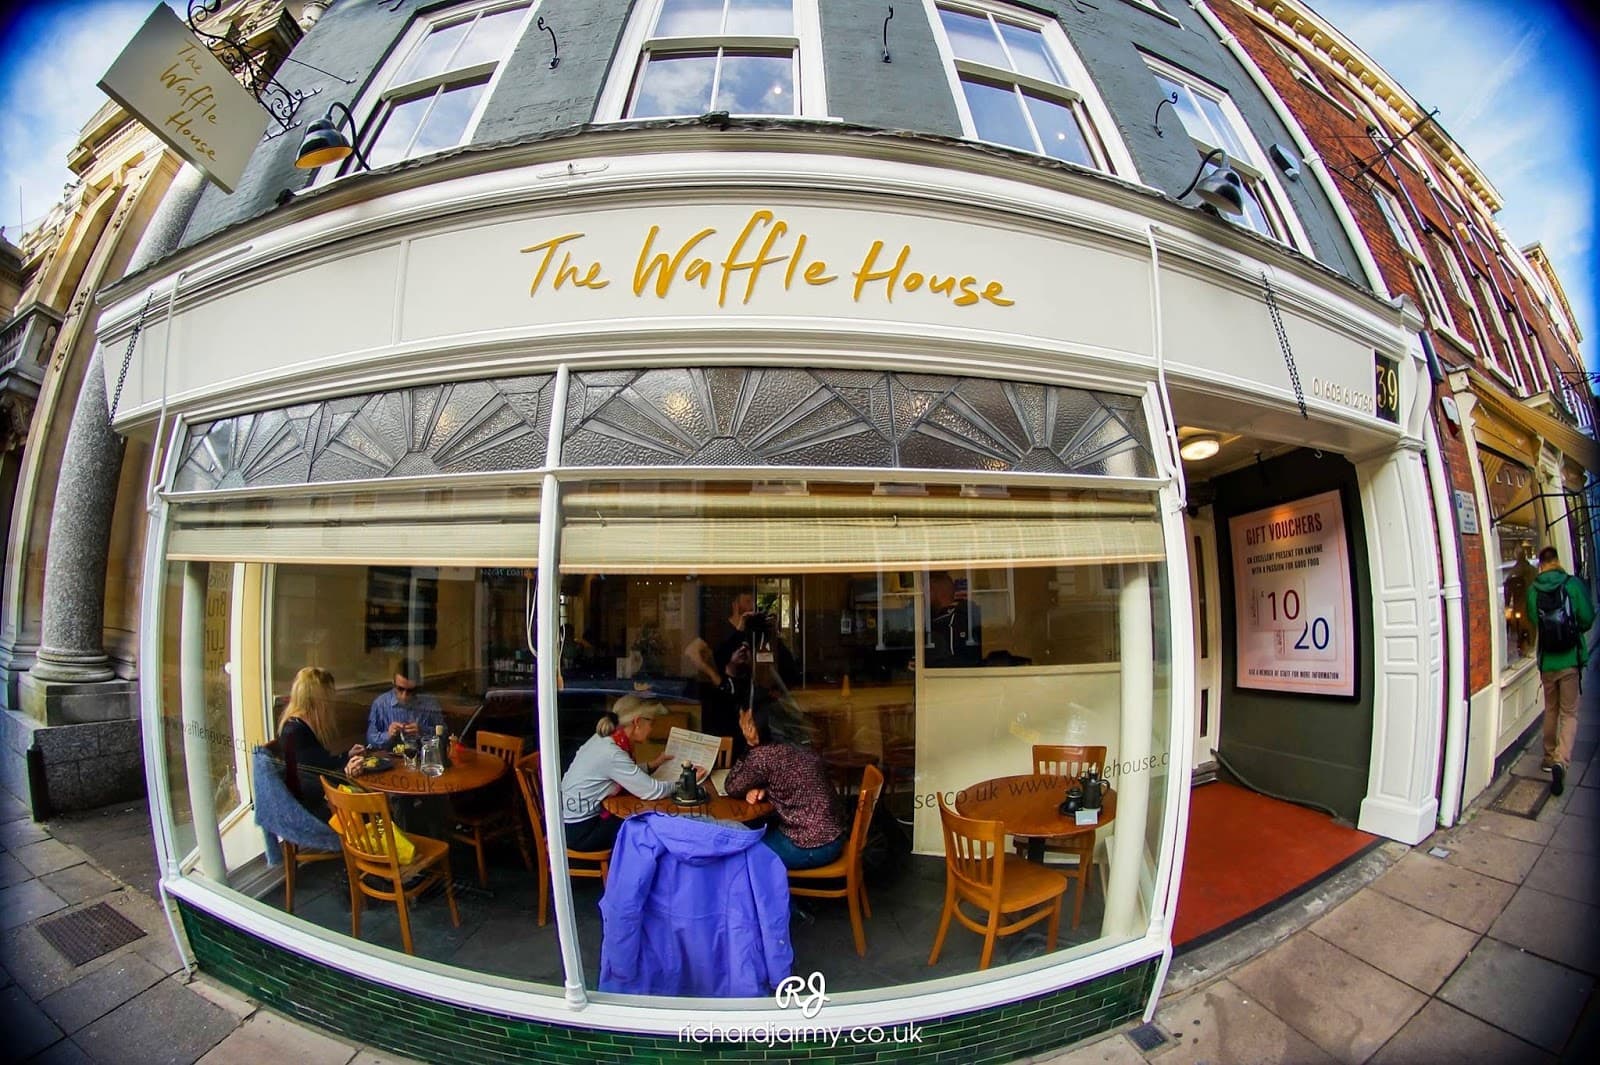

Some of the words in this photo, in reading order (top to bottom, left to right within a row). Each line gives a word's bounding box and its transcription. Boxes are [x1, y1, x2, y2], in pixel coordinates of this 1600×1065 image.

[177, 39, 203, 72] The
[160, 63, 217, 125] Waffle
[165, 111, 217, 162] House
[520, 232, 611, 297] The
[633, 209, 838, 308] Waffle
[853, 240, 1016, 306] House
[1313, 377, 1342, 402] 01603
[1376, 364, 1398, 412] 39
[1246, 524, 1266, 546] GIFT
[1269, 513, 1323, 541] VOUCHERS
[1275, 549, 1294, 560] PRESENT
[1295, 547, 1304, 557] FOR
[1304, 543, 1323, 555] ANYONE
[1294, 617, 1330, 650] 20
[1311, 671, 1340, 680] INFORMATION
